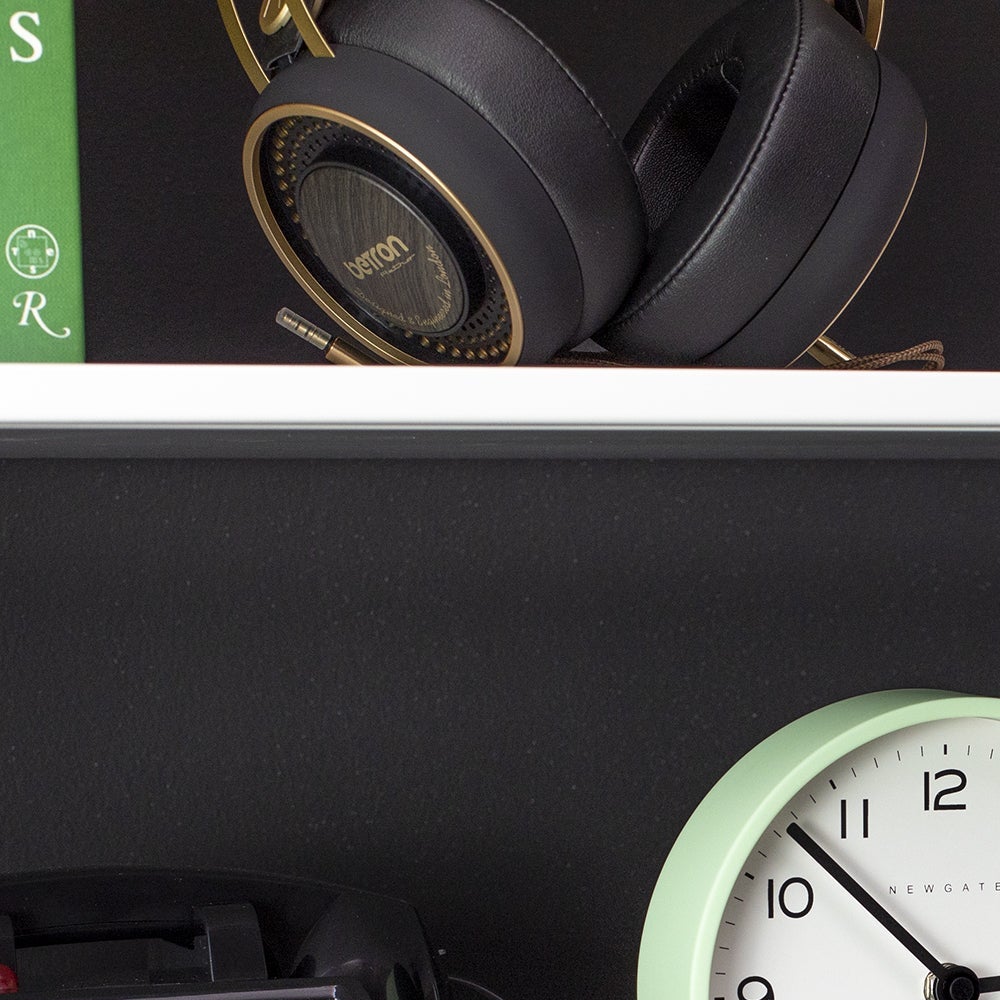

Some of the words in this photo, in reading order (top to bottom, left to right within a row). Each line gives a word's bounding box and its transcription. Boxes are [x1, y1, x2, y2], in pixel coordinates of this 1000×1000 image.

[9, 10, 43, 63] S
[343, 235, 409, 279] betron
[12, 290, 72, 339] R
[922, 768, 967, 811] 12
[840, 798, 869, 839] 11
[766, 876, 814, 919] 10
